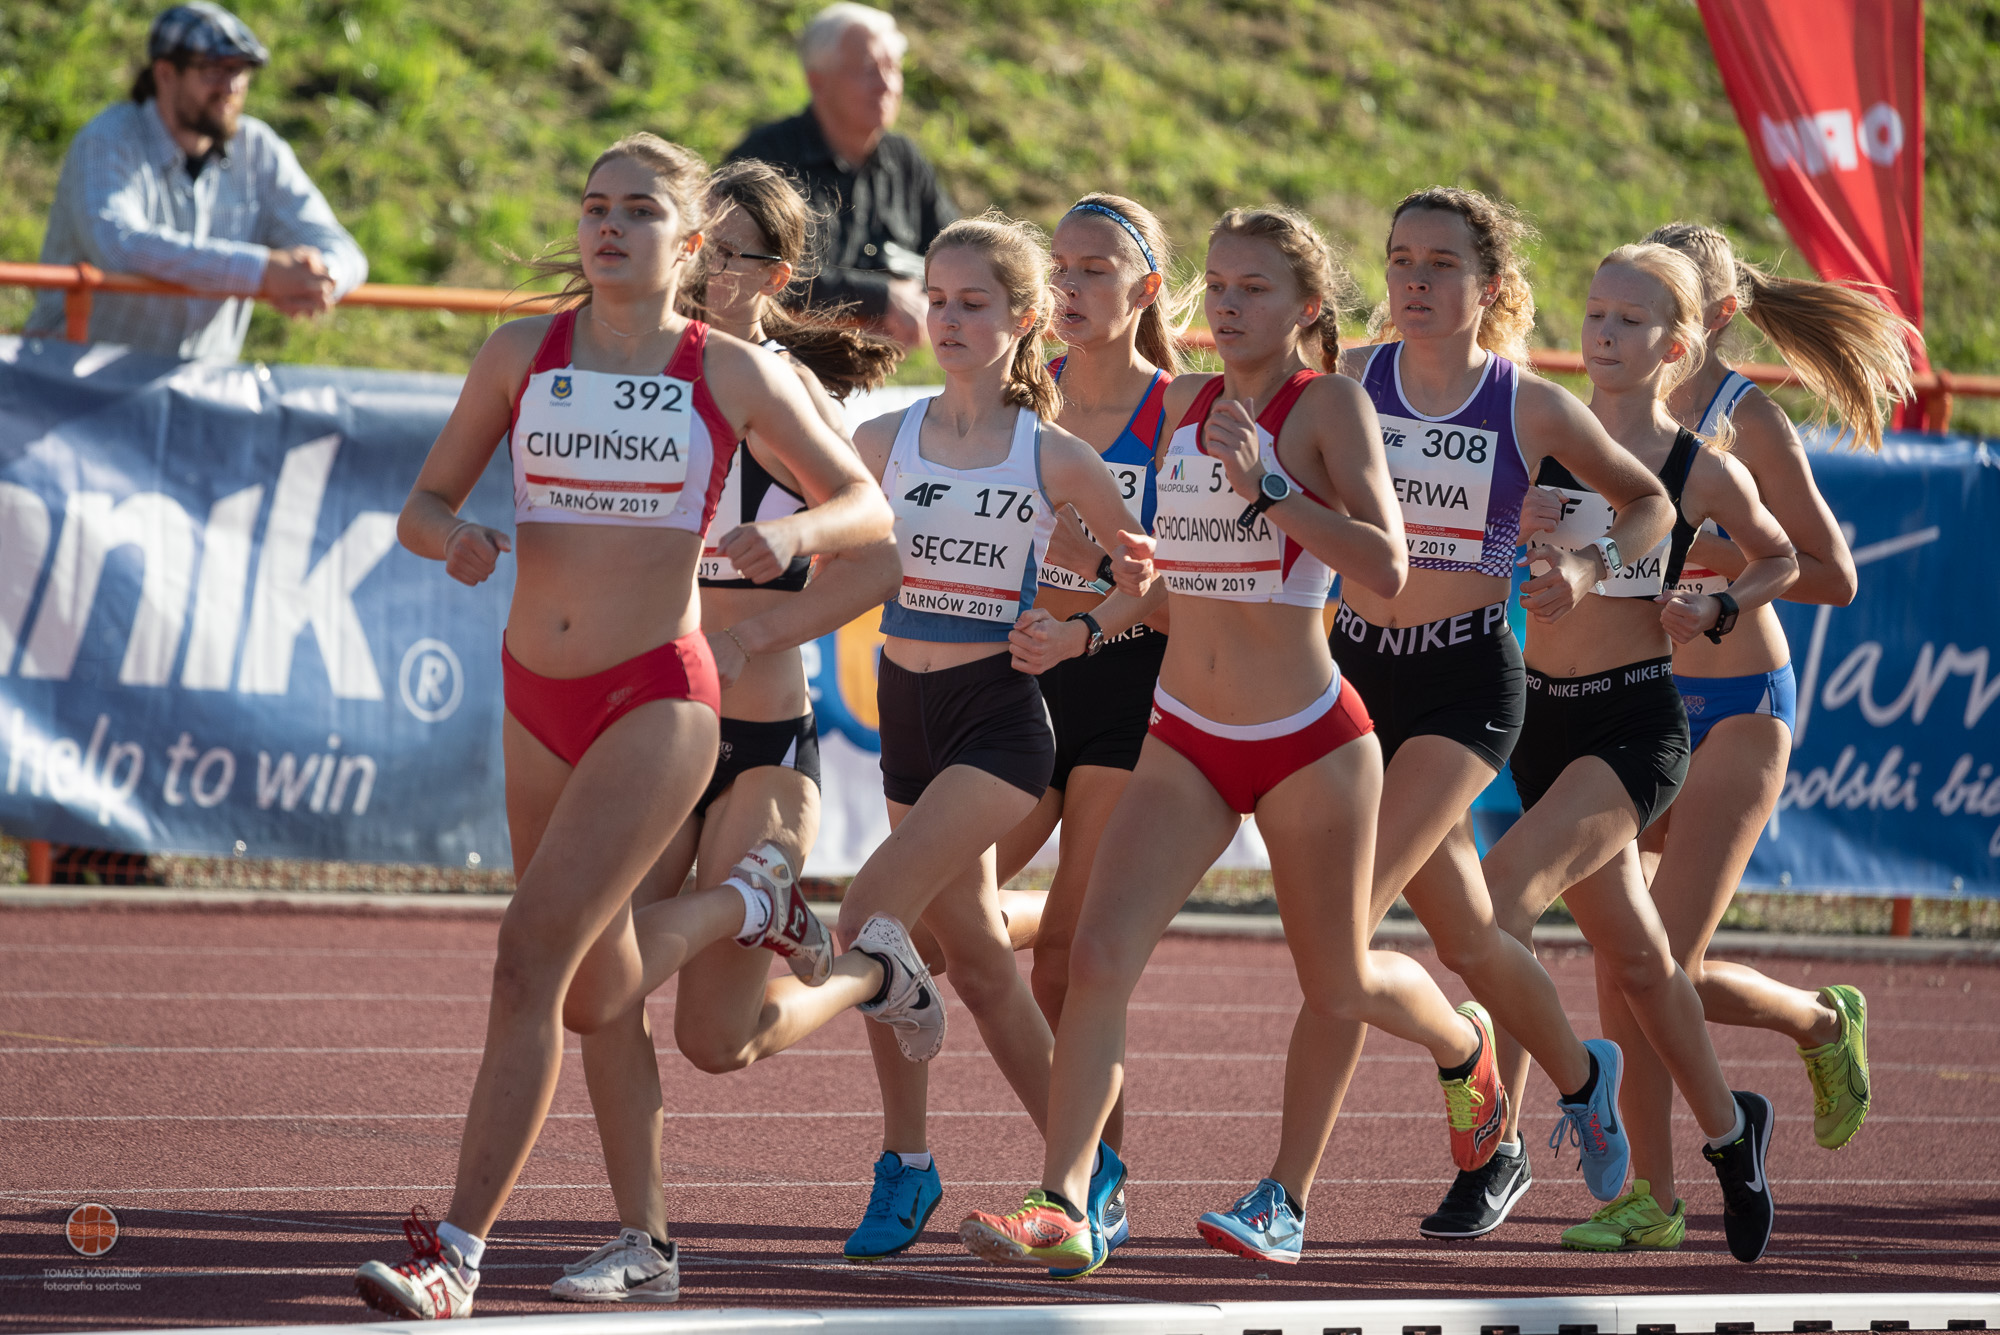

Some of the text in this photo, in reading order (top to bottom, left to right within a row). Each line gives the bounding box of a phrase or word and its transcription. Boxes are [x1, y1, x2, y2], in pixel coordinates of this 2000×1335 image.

[613, 380, 683, 412] 392
[526, 429, 680, 463] CIUPIŃSKA
[1421, 428, 1488, 464] 308
[1109, 469, 1137, 499] 3
[1209, 463, 1234, 493] 5
[1392, 477, 1470, 510] ERWA
[549, 491, 659, 513] TARNÓW 2019
[904, 482, 951, 507] 4F
[974, 488, 1034, 523] 176
[910, 534, 1009, 570] SĘCZEK
[1419, 540, 1456, 556] 2019
[1039, 567, 1073, 585] NÓW
[1168, 574, 1256, 592] TARNÓW 2019
[1615, 557, 1661, 579] SKA
[905, 592, 1004, 618] TARNÓW 2019
[1336, 599, 1367, 643] RO
[1377, 611, 1473, 656] NIKE
[1795, 521, 2000, 748] Tar
[1525, 674, 1542, 691] RO
[1548, 683, 1579, 698] NIKE
[1582, 677, 1612, 696] PRO
[1624, 664, 1660, 686] NIKE
[6, 708, 378, 826] help to win
